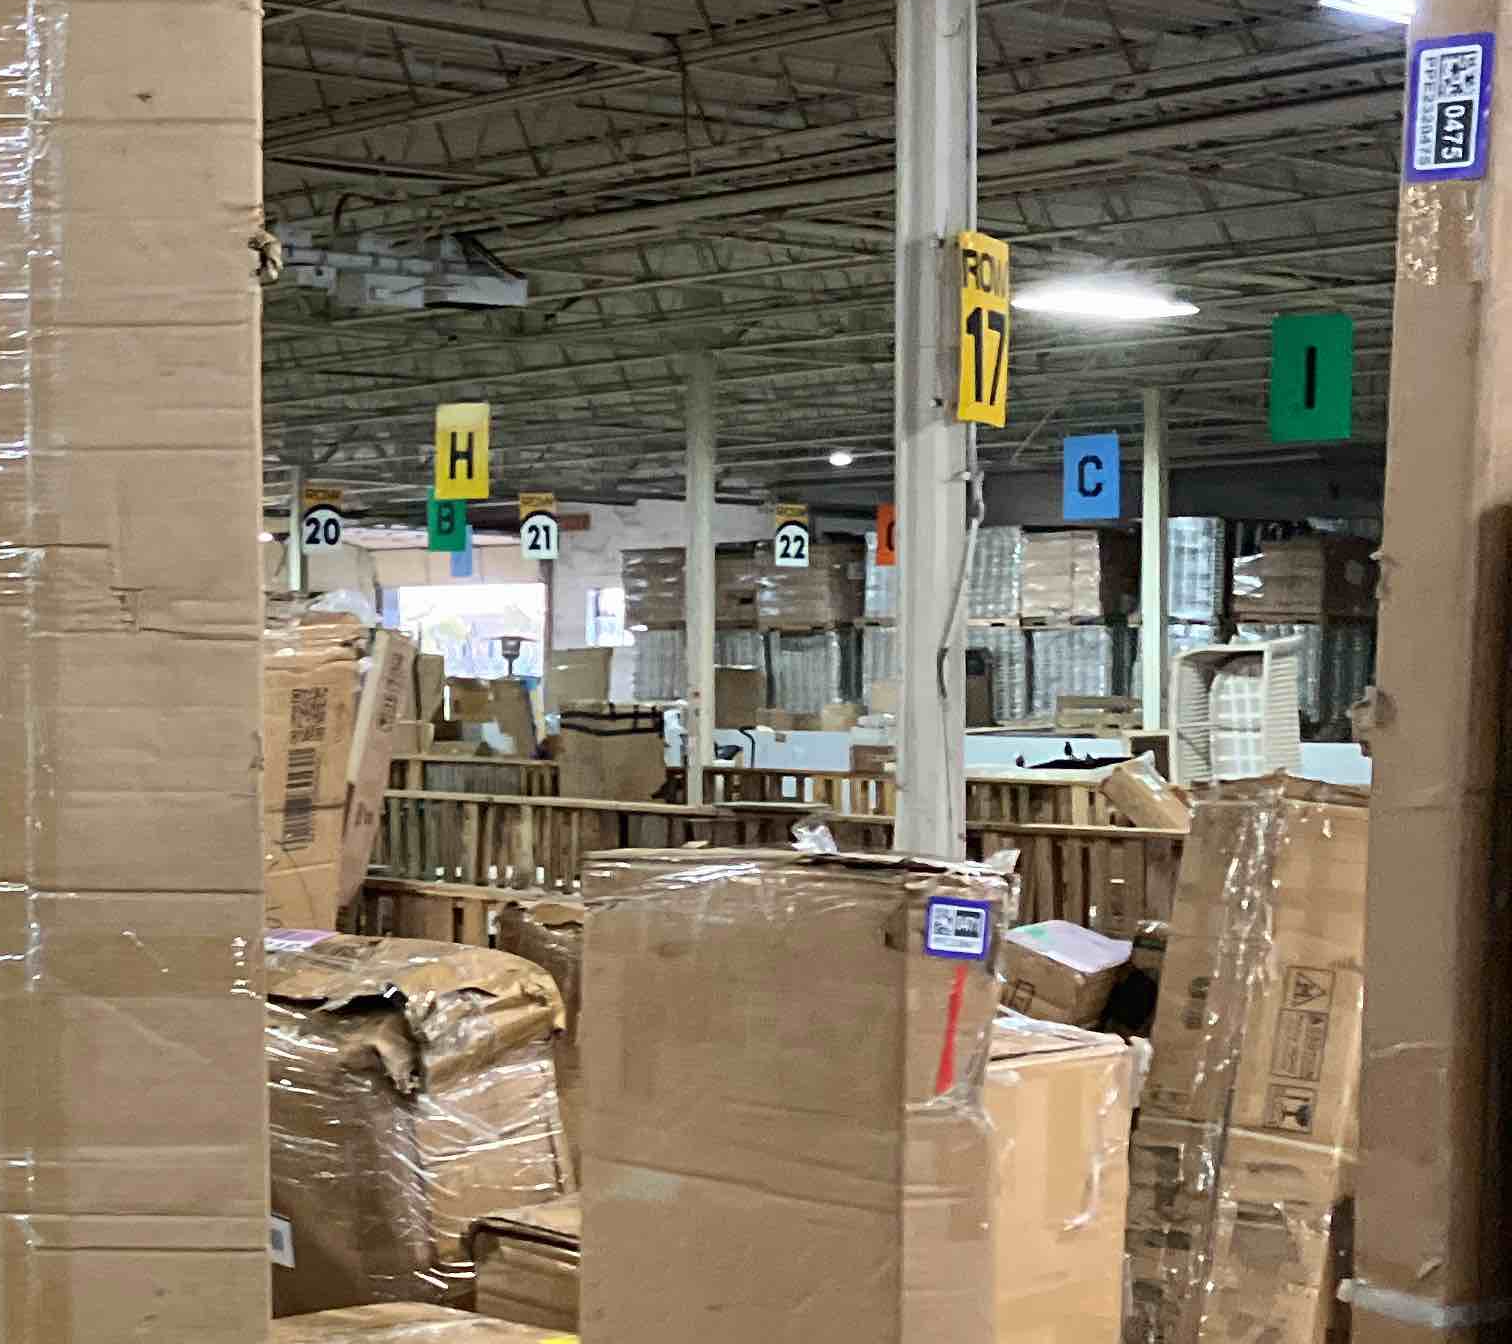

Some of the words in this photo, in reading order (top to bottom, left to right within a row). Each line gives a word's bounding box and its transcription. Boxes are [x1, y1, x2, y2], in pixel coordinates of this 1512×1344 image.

[1440, 104, 1465, 160] 0475
[962, 248, 1008, 299] ROW
[966, 306, 1005, 406] 17
[448, 431, 475, 480] H
[1077, 455, 1103, 498] C
[305, 517, 341, 545] 20
[438, 502, 455, 535] B
[528, 525, 551, 550] 21
[779, 534, 805, 559] 22
